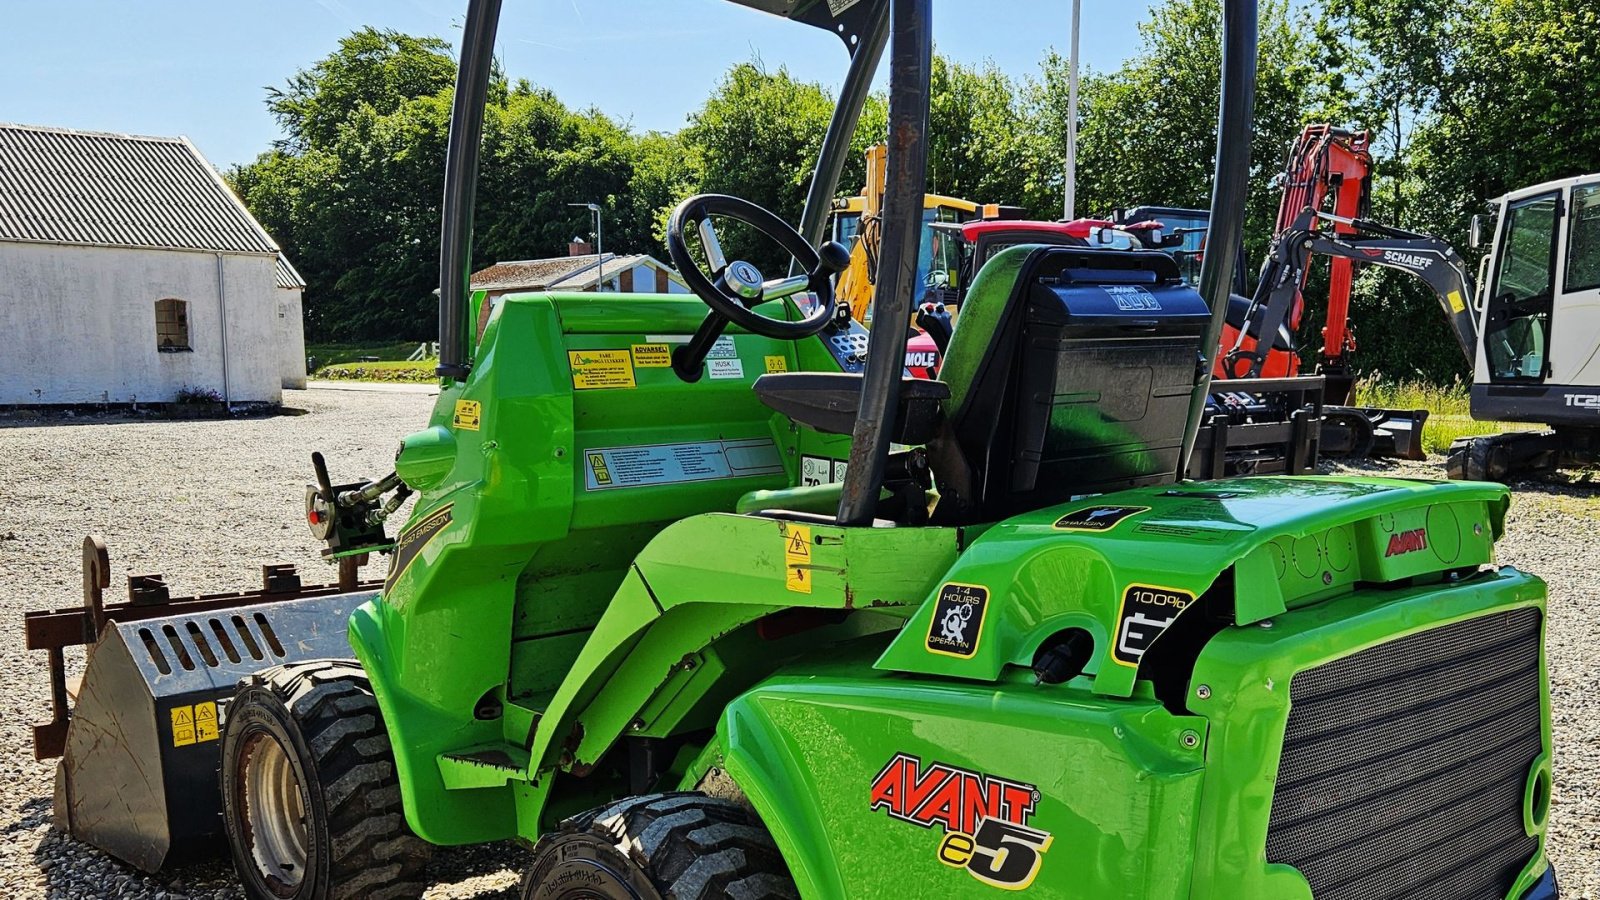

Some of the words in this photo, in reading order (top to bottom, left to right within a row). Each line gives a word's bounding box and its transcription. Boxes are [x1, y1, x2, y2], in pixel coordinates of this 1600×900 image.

[1384, 250, 1433, 268] SCHAEFF
[904, 352, 935, 368] MOLE
[1563, 393, 1600, 407] TC2
[416, 514, 449, 538] EMISSION
[1385, 528, 1427, 557] AVANT
[956, 586, 971, 595] 1-4
[943, 593, 981, 605] HOURS
[1133, 591, 1187, 609] 100%
[928, 636, 970, 649] OPERATIN
